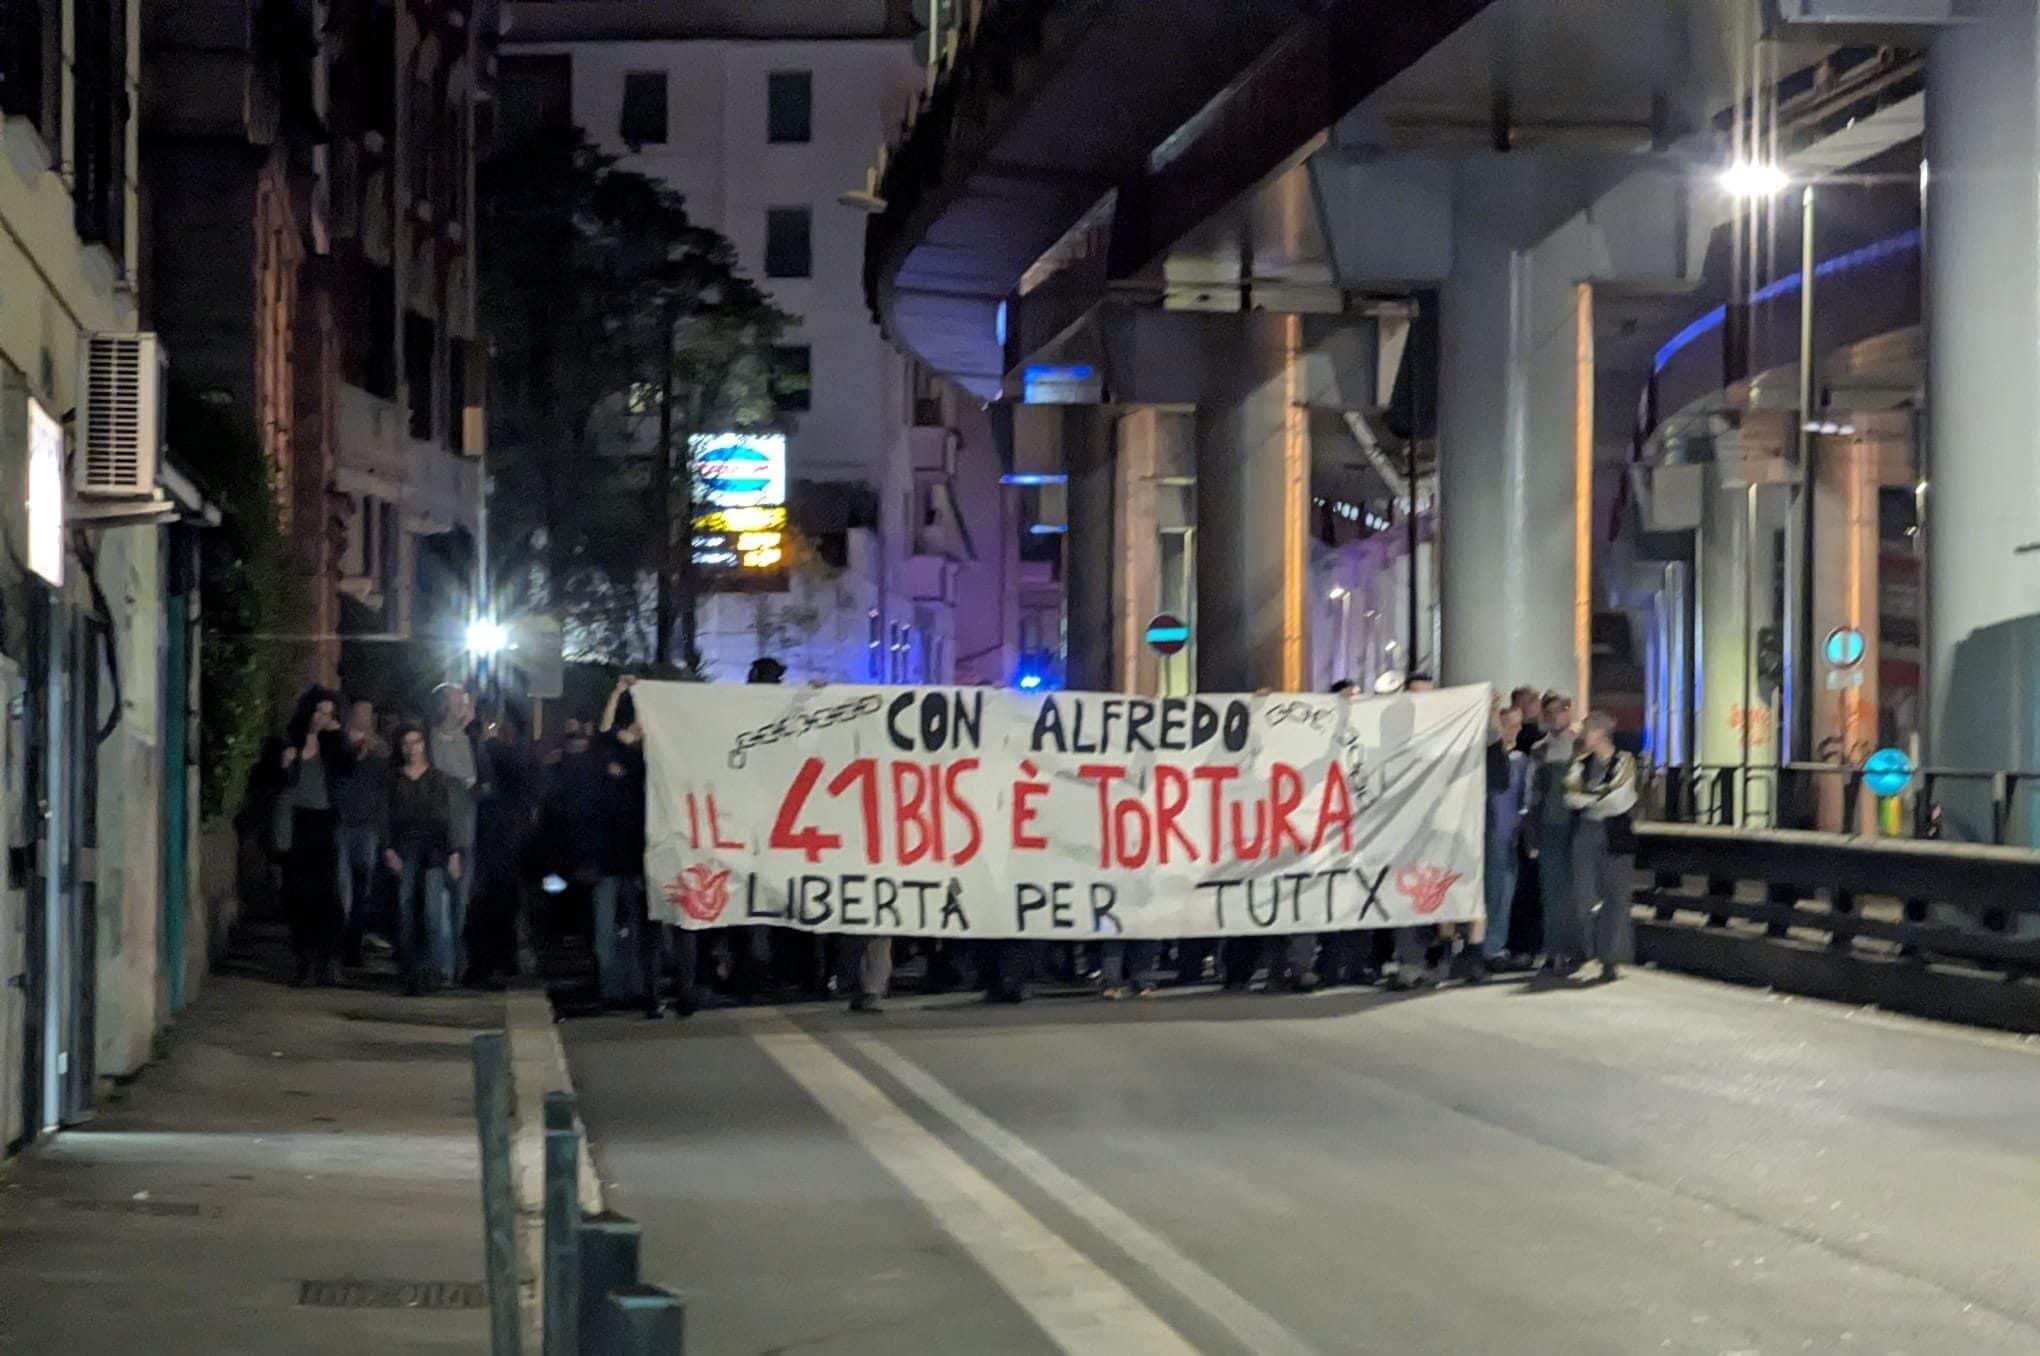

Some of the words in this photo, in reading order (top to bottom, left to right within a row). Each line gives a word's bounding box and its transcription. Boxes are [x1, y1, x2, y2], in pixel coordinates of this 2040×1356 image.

[887, 691, 984, 752] CON
[1032, 695, 1250, 753] ALFREDO
[686, 792, 745, 850] IL
[1011, 759, 1050, 850] È
[1016, 881, 1122, 934] PER
[1195, 864, 1391, 930] TUTTX
